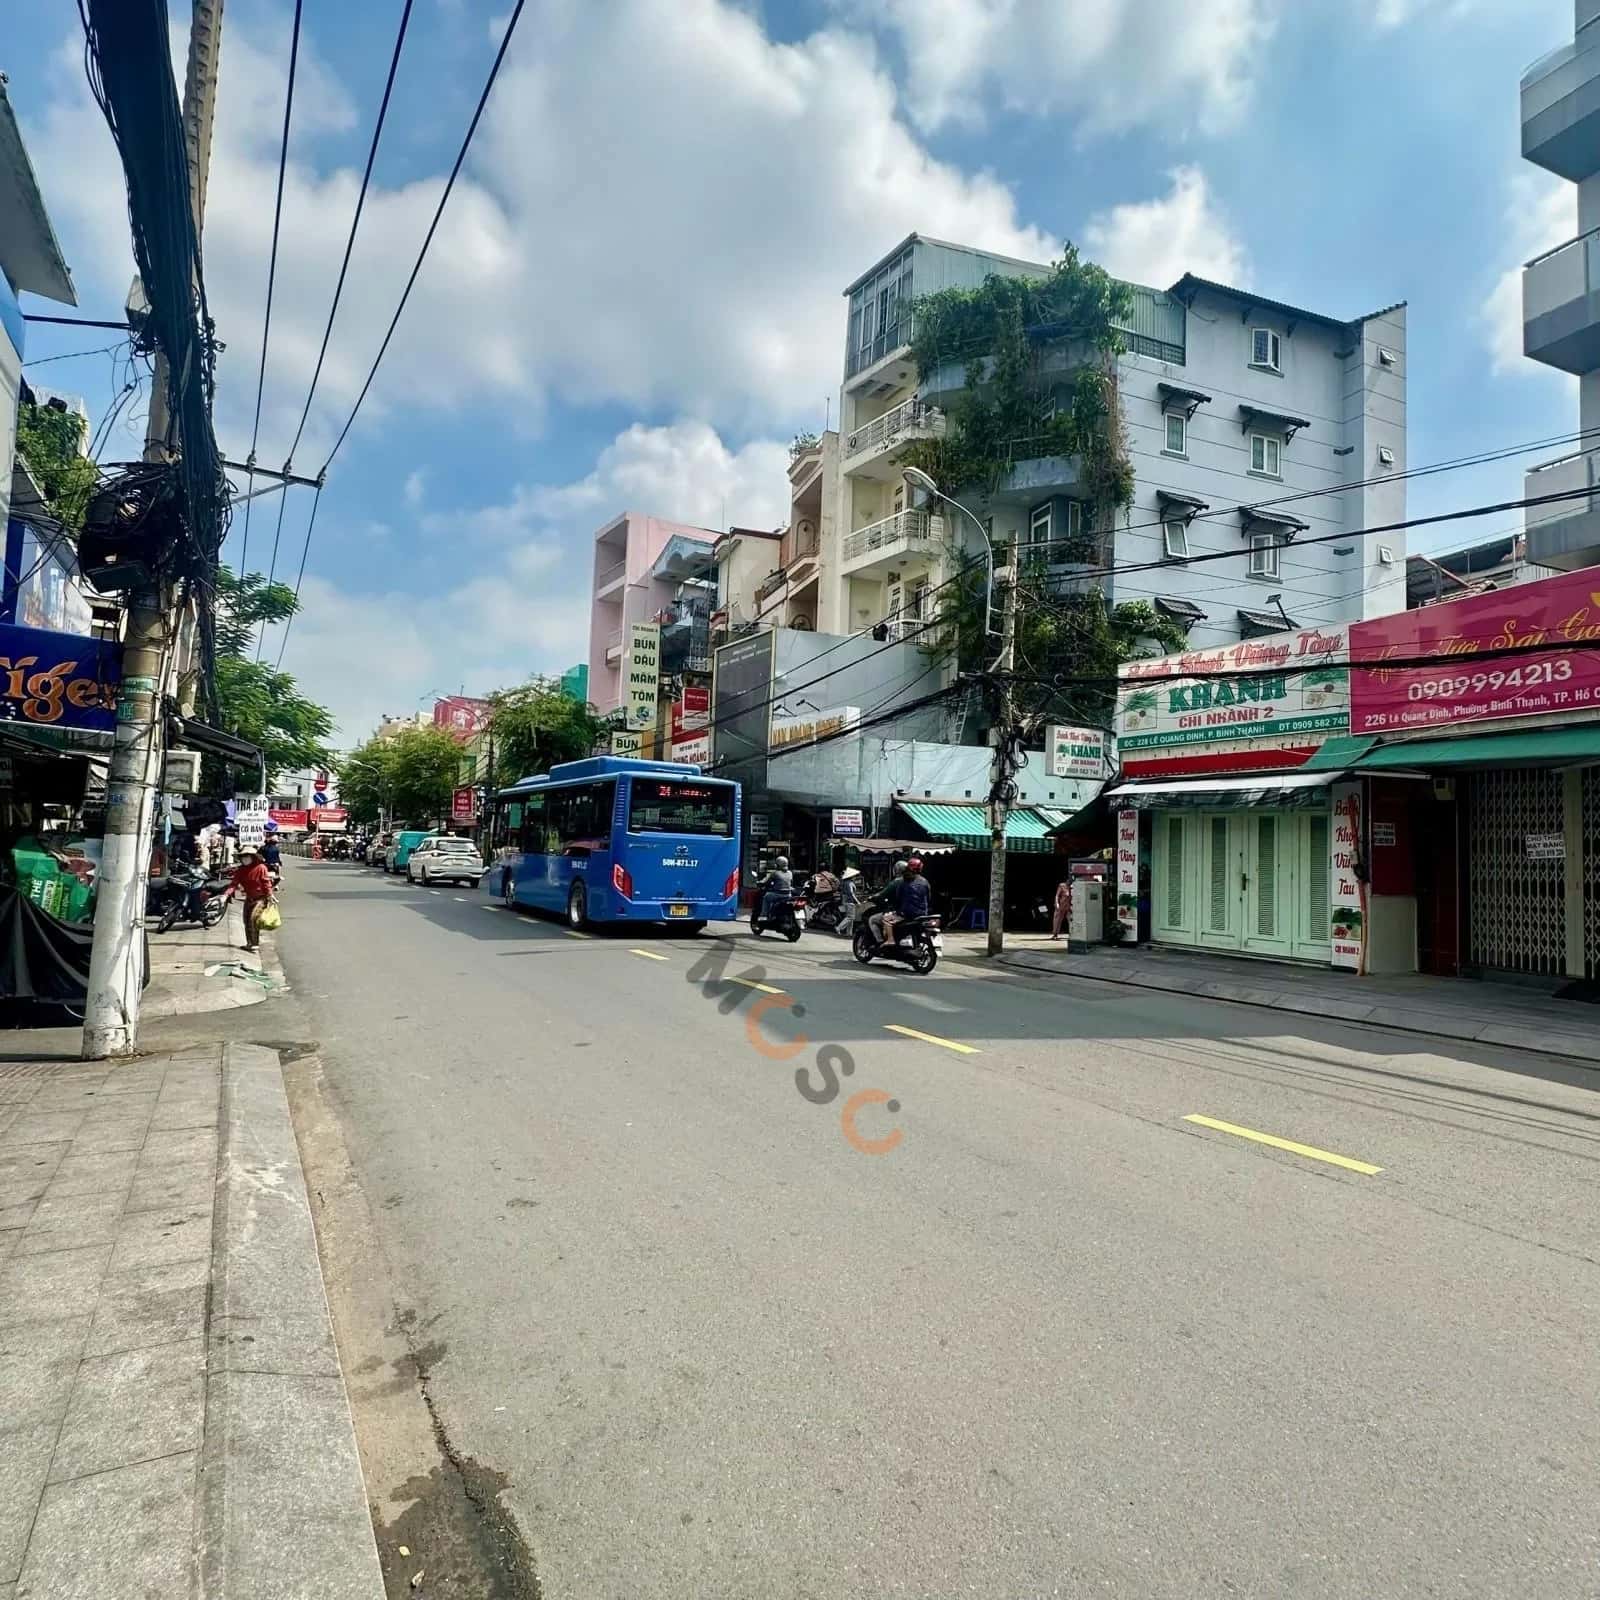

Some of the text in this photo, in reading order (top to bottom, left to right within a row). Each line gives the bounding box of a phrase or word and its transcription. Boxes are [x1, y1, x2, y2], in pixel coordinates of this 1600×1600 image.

[634, 637, 656, 650] BÚN
[1230, 643, 1291, 667] Vũng
[1296, 630, 1345, 657] Tàu
[1408, 659, 1573, 701] 0909994213
[1180, 715, 1202, 729] CHI
[1263, 706, 1274, 718] 2
[1365, 714, 1387, 727] 226
[1553, 691, 1572, 703] TP.
[1292, 719, 1313, 730] 0909
